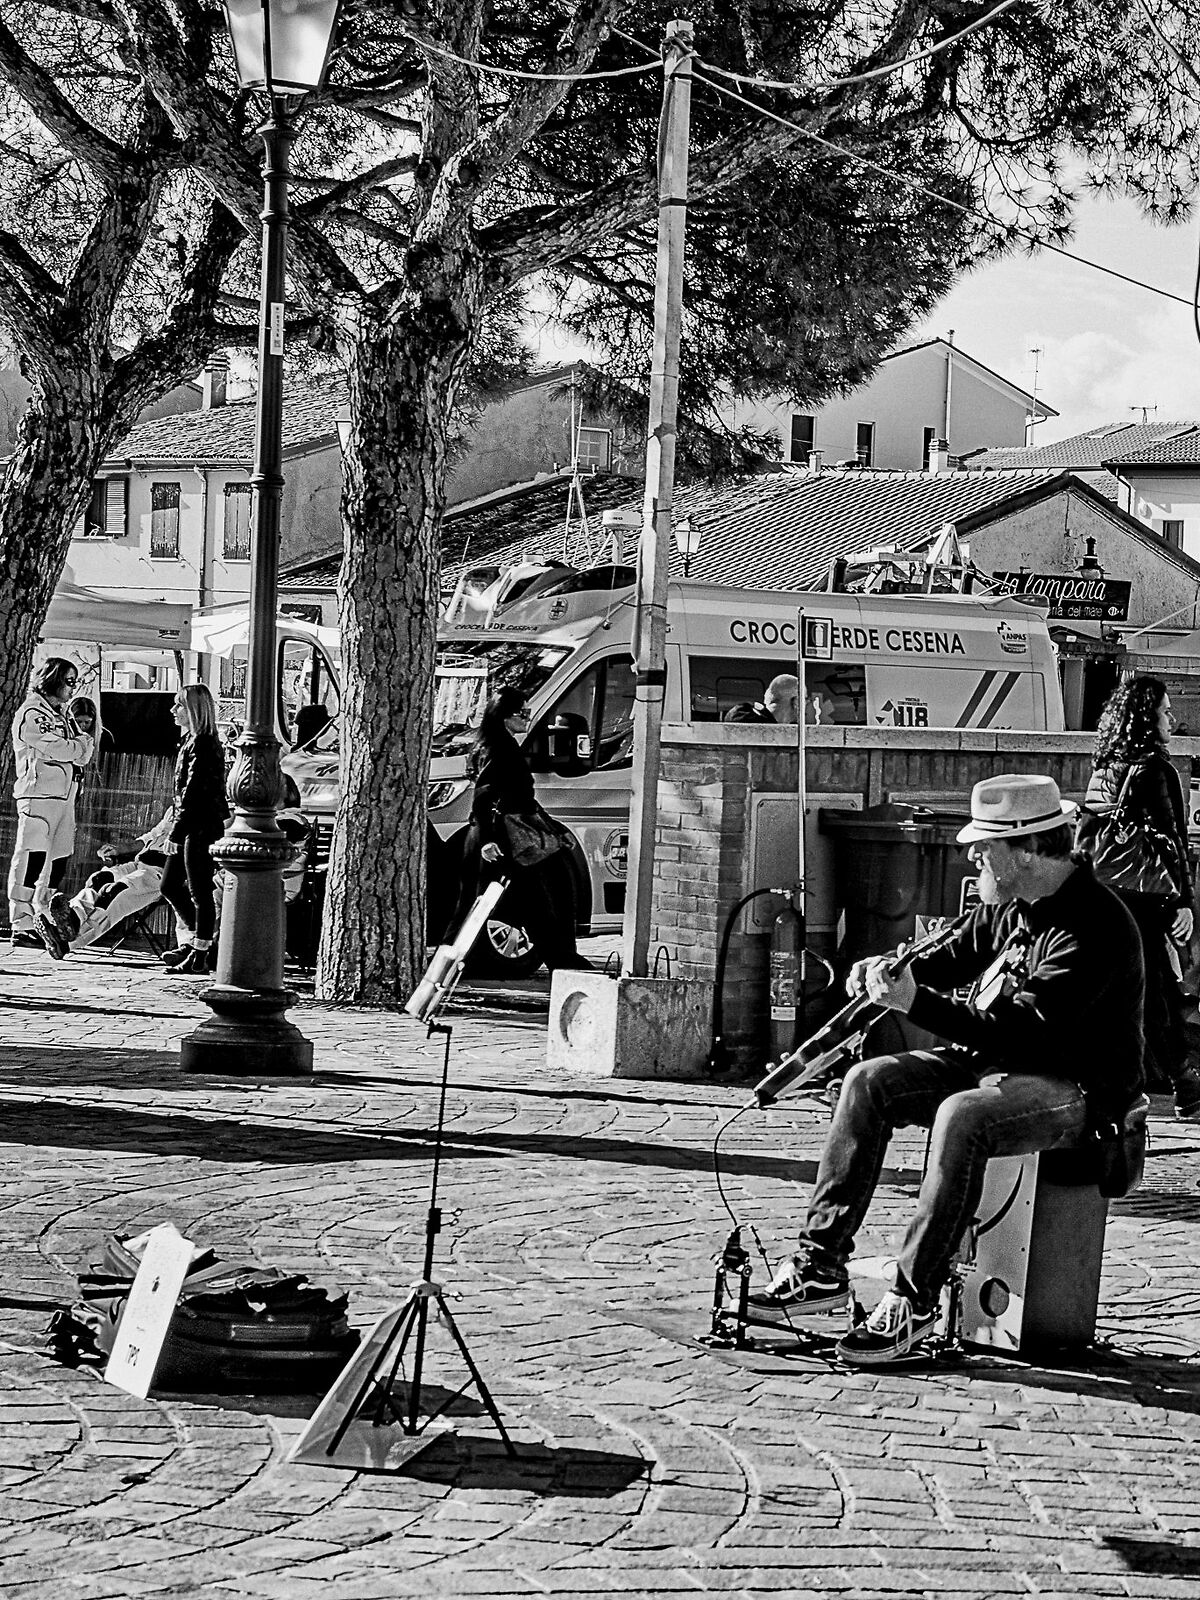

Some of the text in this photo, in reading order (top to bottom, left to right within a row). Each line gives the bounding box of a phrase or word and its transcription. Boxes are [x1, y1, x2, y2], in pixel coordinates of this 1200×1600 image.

[729, 620, 966, 655] CROC ERDE CESENA
[897, 705, 928, 727] 118
